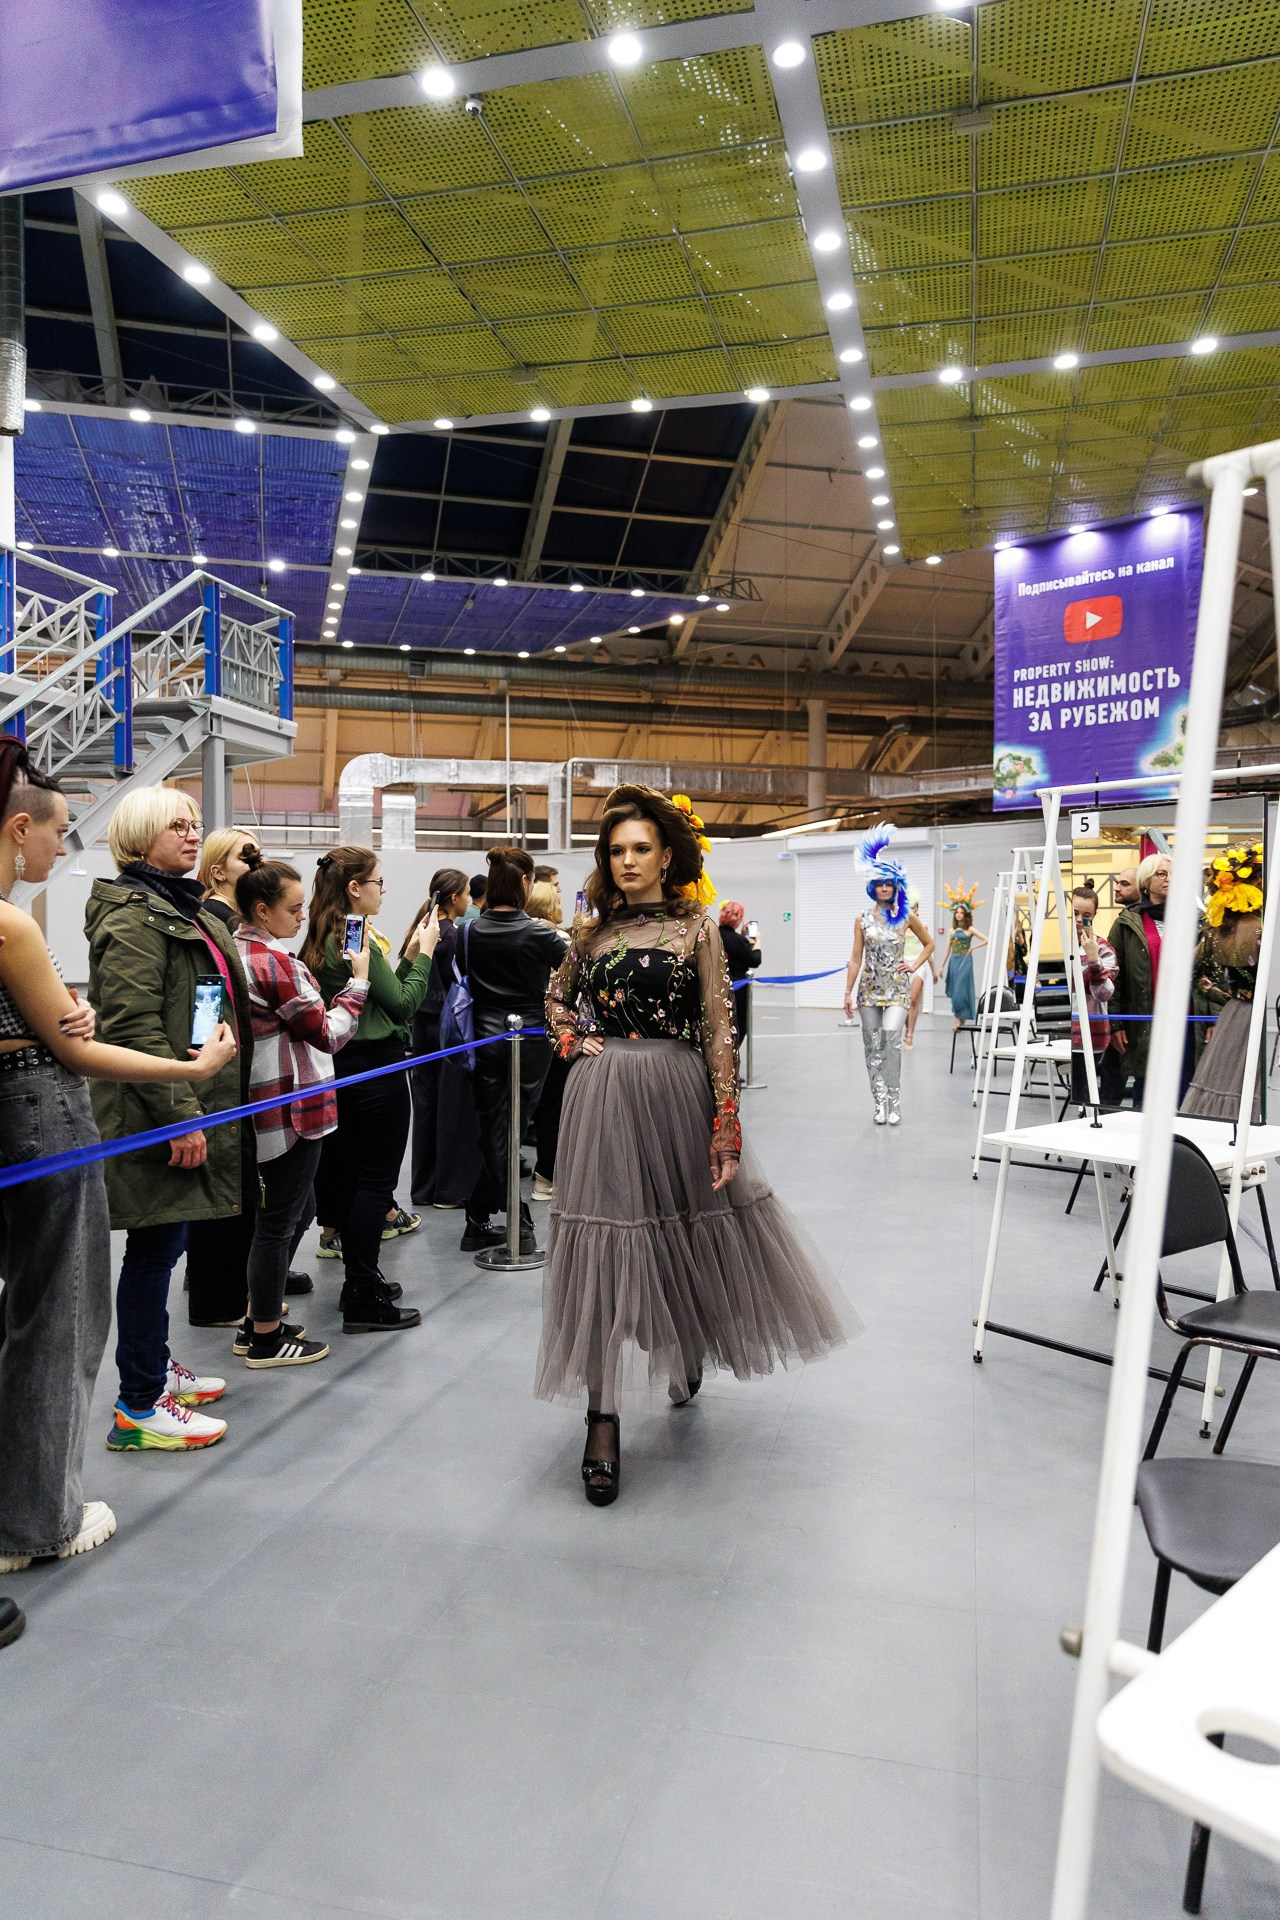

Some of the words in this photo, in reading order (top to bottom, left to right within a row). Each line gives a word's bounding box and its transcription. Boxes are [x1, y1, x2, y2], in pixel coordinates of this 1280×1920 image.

[1018, 569, 1115, 597] Подписывайтесь
[1118, 564, 1133, 577] на
[1136, 557, 1174, 574] канал
[1013, 662, 1071, 682] PROPERTY
[1075, 655, 1114, 673] SHOW:
[1013, 667, 1181, 708] НЕДВИЖИМОСТЬ
[1028, 710, 1052, 732] ЗА
[1060, 696, 1160, 729] РУБЕЖОМ
[1080, 816, 1089, 832] 5
